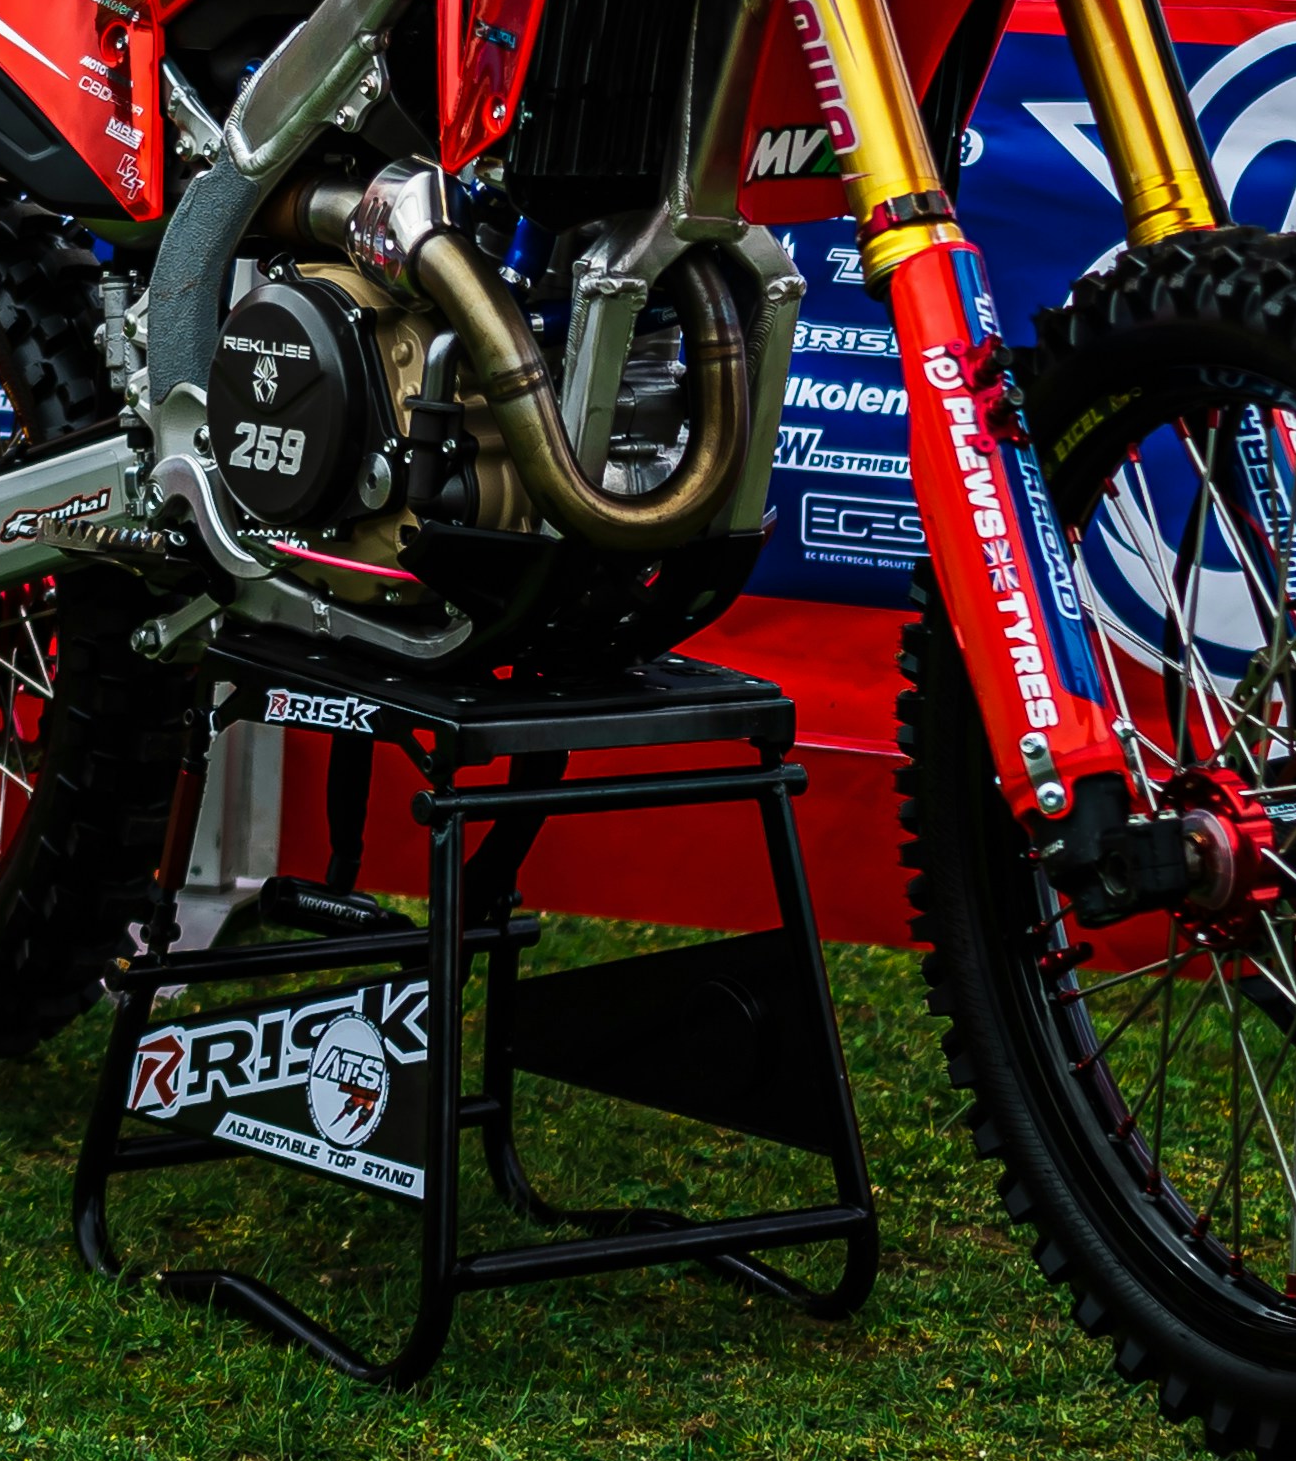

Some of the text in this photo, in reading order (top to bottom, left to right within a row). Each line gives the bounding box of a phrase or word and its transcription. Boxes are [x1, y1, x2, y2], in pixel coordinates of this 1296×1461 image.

[116, 153, 146, 200] K2T
[223, 335, 312, 362] REKLUSE
[229, 421, 307, 477] 259
[808, 453, 909, 475] DISTRIBU
[942, 396, 1009, 540] PLEWS
[5, 493, 109, 540] Renthal
[819, 553, 874, 567] ELECTRICAL
[990, 586, 1059, 730] TYRES
[287, 693, 381, 734] RISK
[186, 980, 429, 1099] RISK
[225, 1119, 416, 1189] ADJUSTABLE TOP STAND
